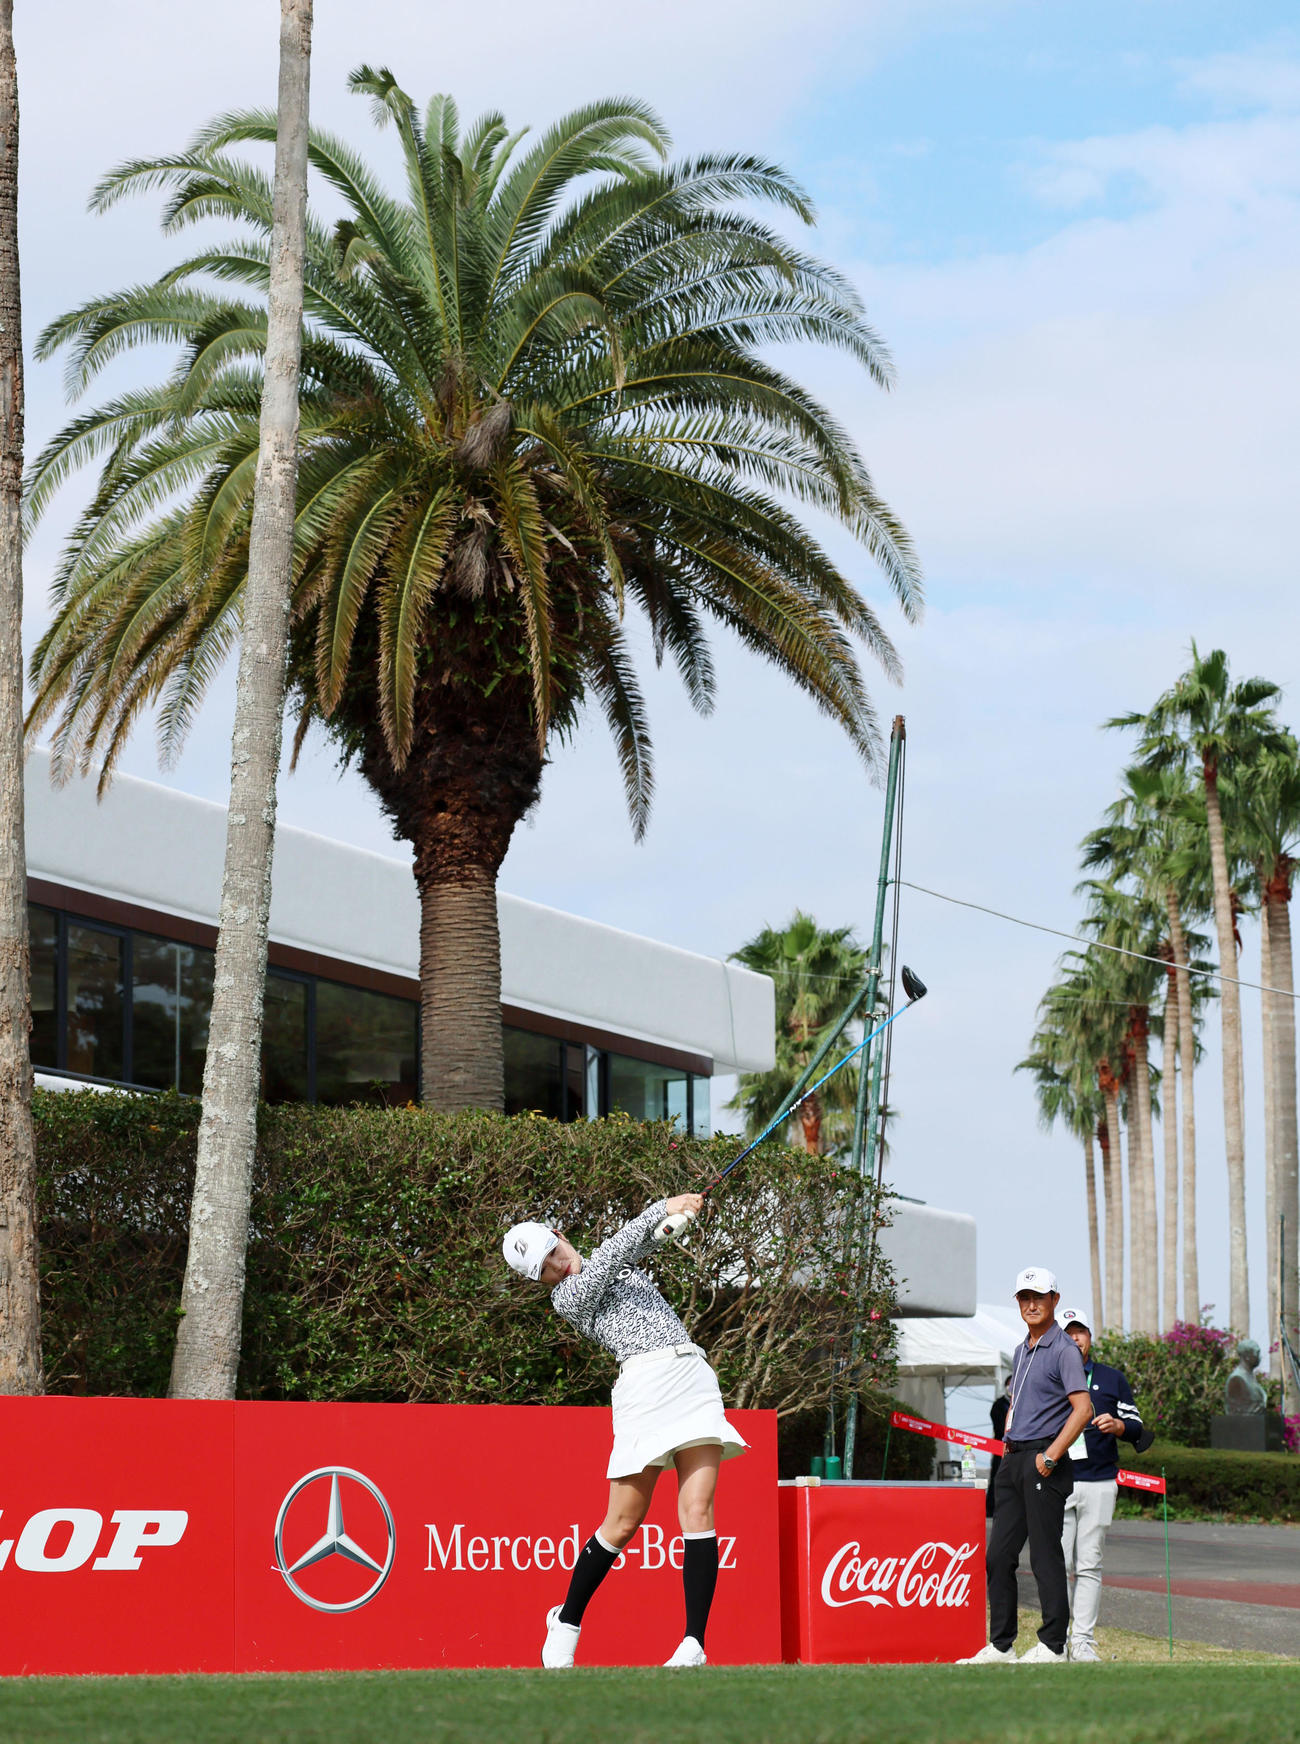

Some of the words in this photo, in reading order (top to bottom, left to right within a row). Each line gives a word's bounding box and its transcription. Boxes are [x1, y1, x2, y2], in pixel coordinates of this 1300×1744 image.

[0, 1508, 189, 1572] OP
[424, 1524, 737, 1570] Merced-Bez
[821, 1541, 980, 1608] Coca-Cola
